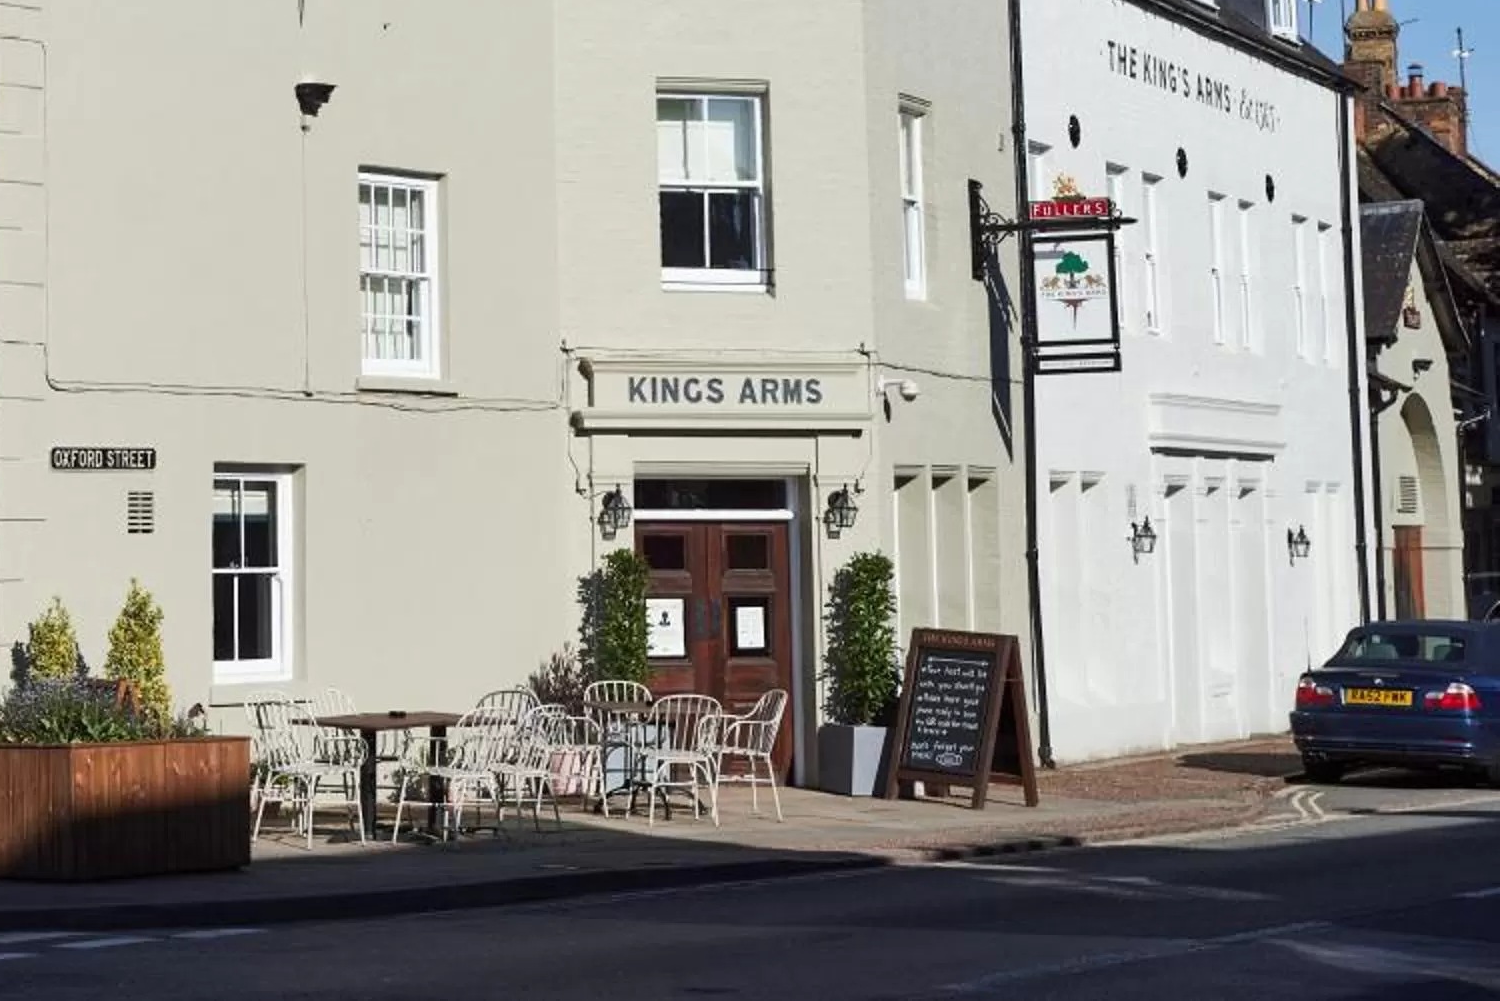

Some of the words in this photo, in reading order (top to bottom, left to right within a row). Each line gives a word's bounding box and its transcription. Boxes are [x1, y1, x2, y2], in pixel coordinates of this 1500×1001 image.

[1107, 40, 1137, 79] THE
[1143, 51, 1190, 98] KING'S
[1196, 73, 1231, 113] ARMS
[628, 376, 725, 405] KINGS
[739, 378, 824, 405] ARMS
[53, 450, 103, 468] OXFORD
[107, 450, 153, 468] STREET
